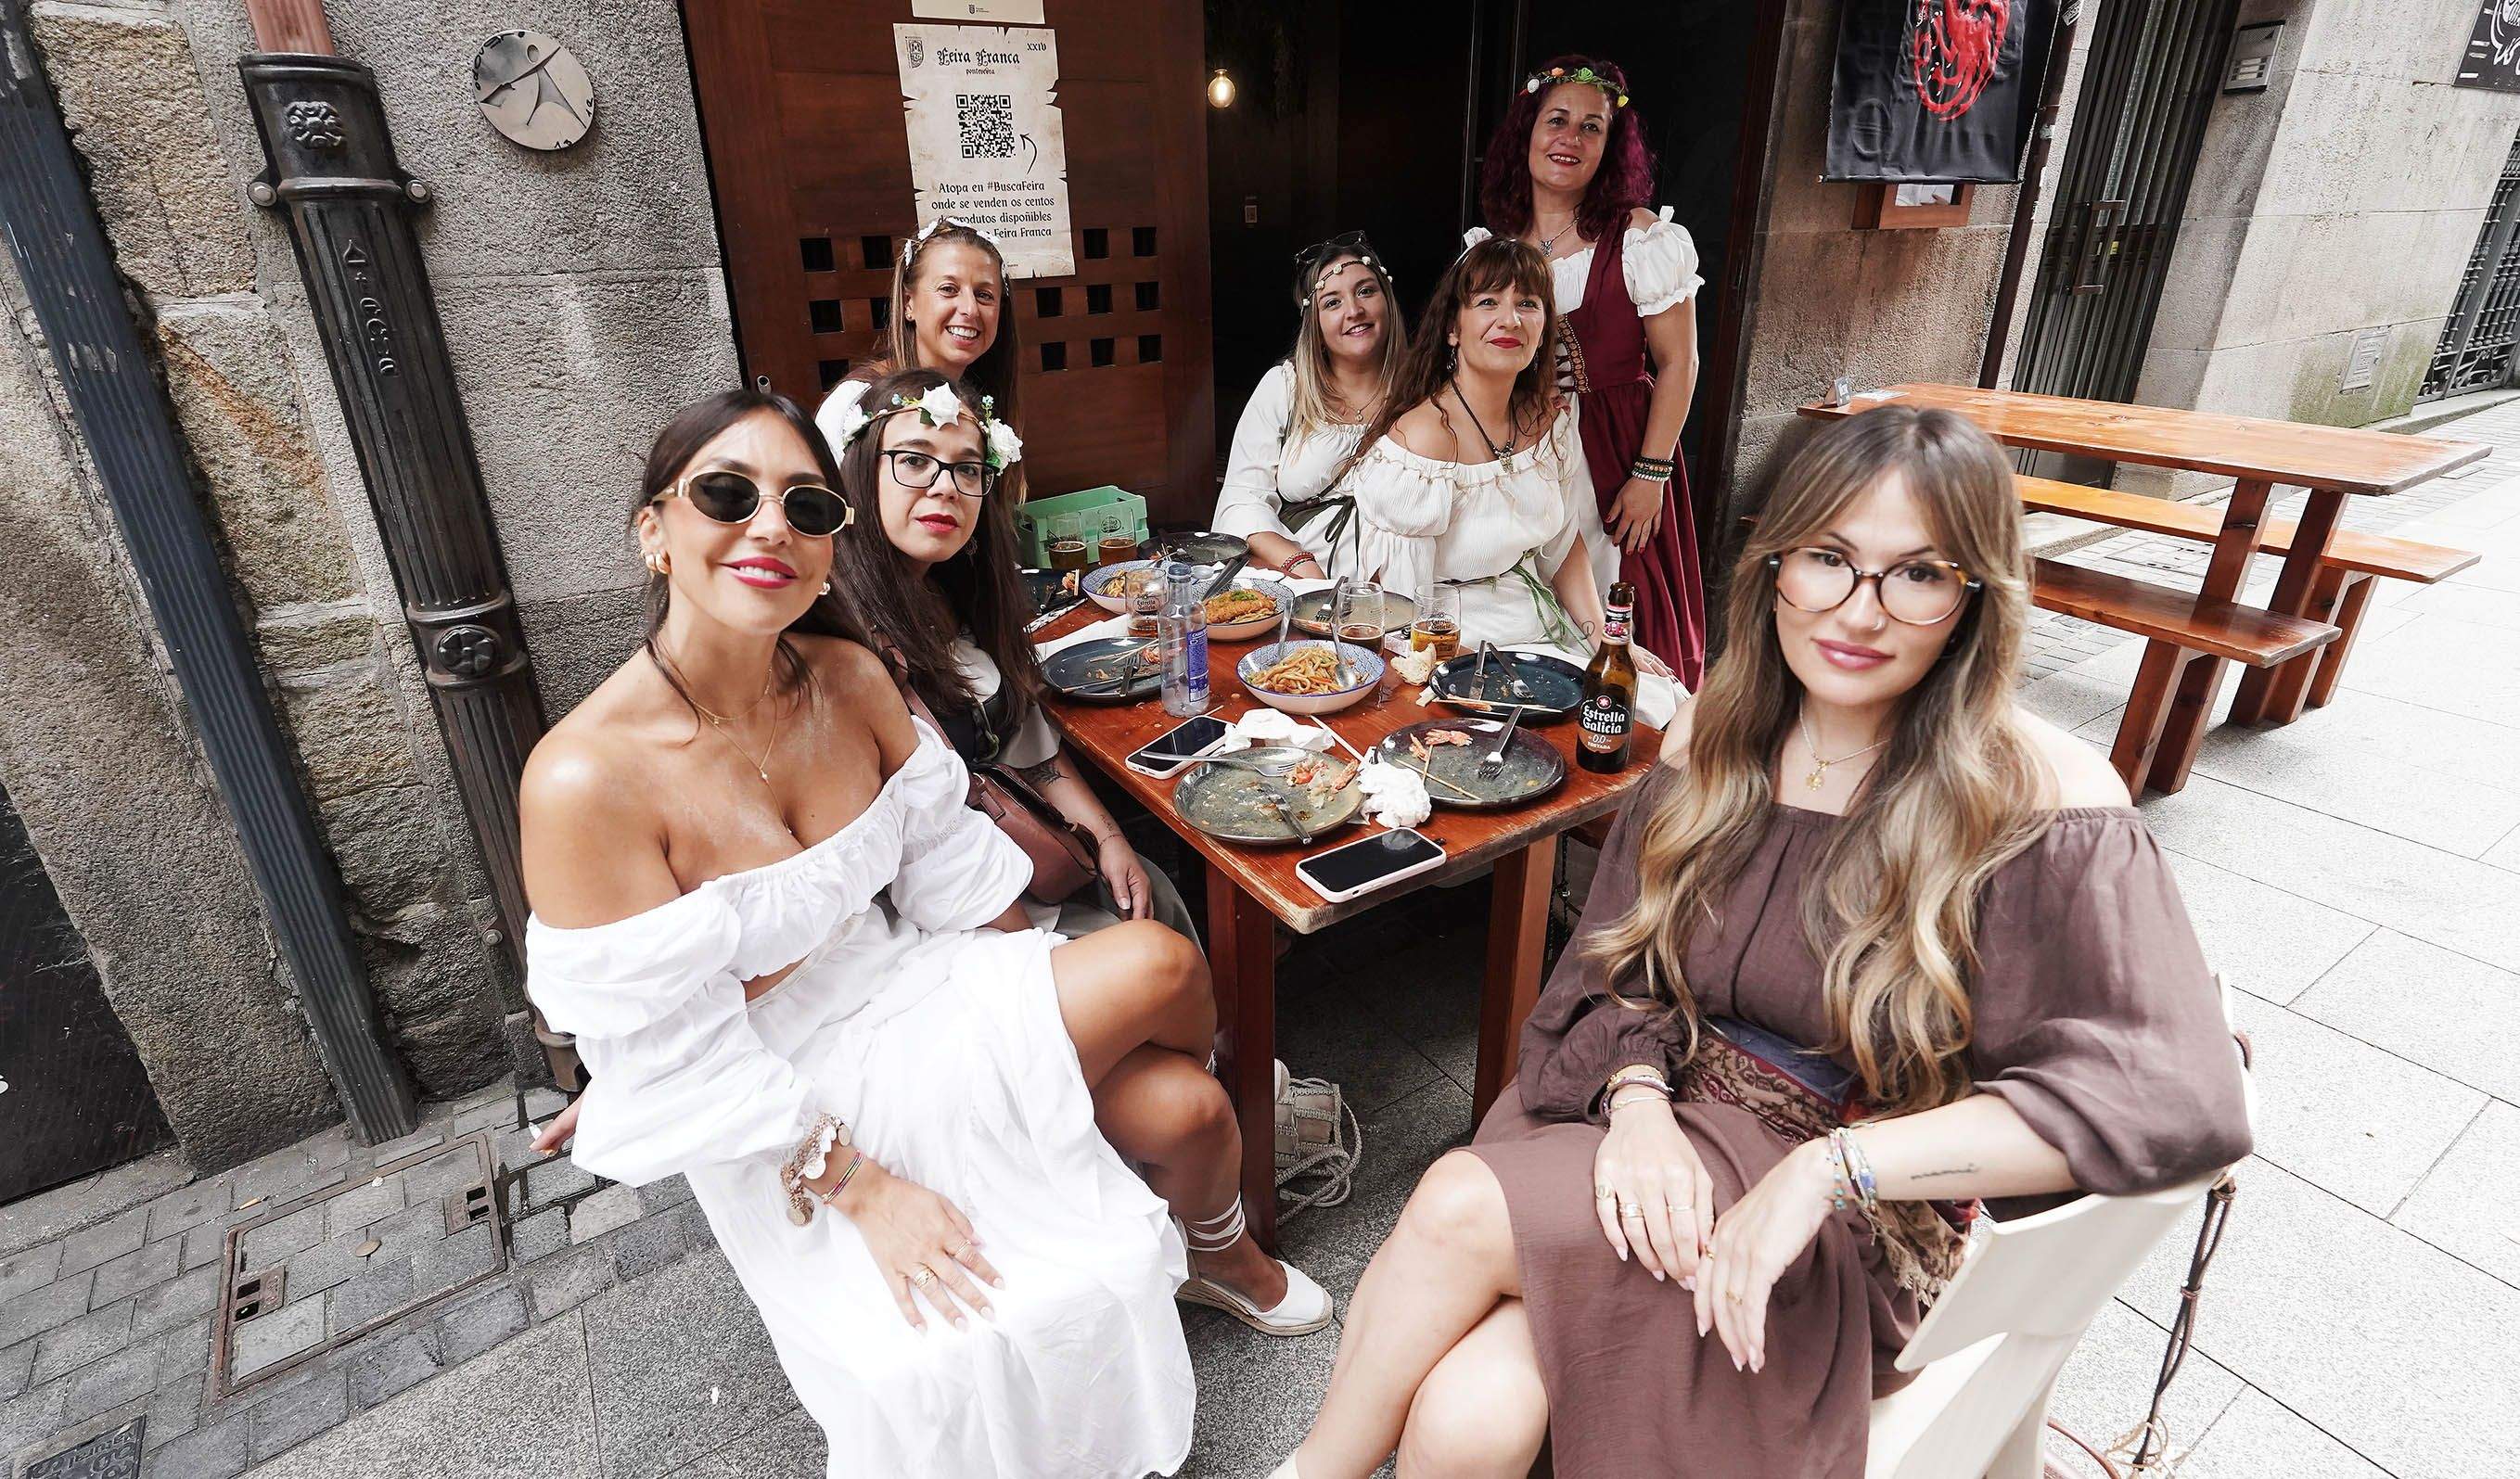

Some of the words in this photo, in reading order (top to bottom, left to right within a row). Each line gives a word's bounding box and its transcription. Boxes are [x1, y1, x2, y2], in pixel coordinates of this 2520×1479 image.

[937, 47, 971, 67] Feira
[975, 48, 1020, 67] Franca
[939, 183, 968, 196] Atopa
[972, 184, 984, 193] en
[987, 181, 1045, 192] #BuscaFeira
[931, 198, 956, 210] onde
[959, 200, 969, 209] se
[973, 198, 1007, 208] venden
[1025, 198, 1055, 207] centos
[953, 213, 997, 223] rodutos
[1000, 211, 1052, 224] dispoñibles
[994, 228, 1017, 238] Feira
[1020, 227, 1052, 237] Franca
[1582, 705, 1625, 723] Estrella
[1582, 717, 1622, 734] Galicia
